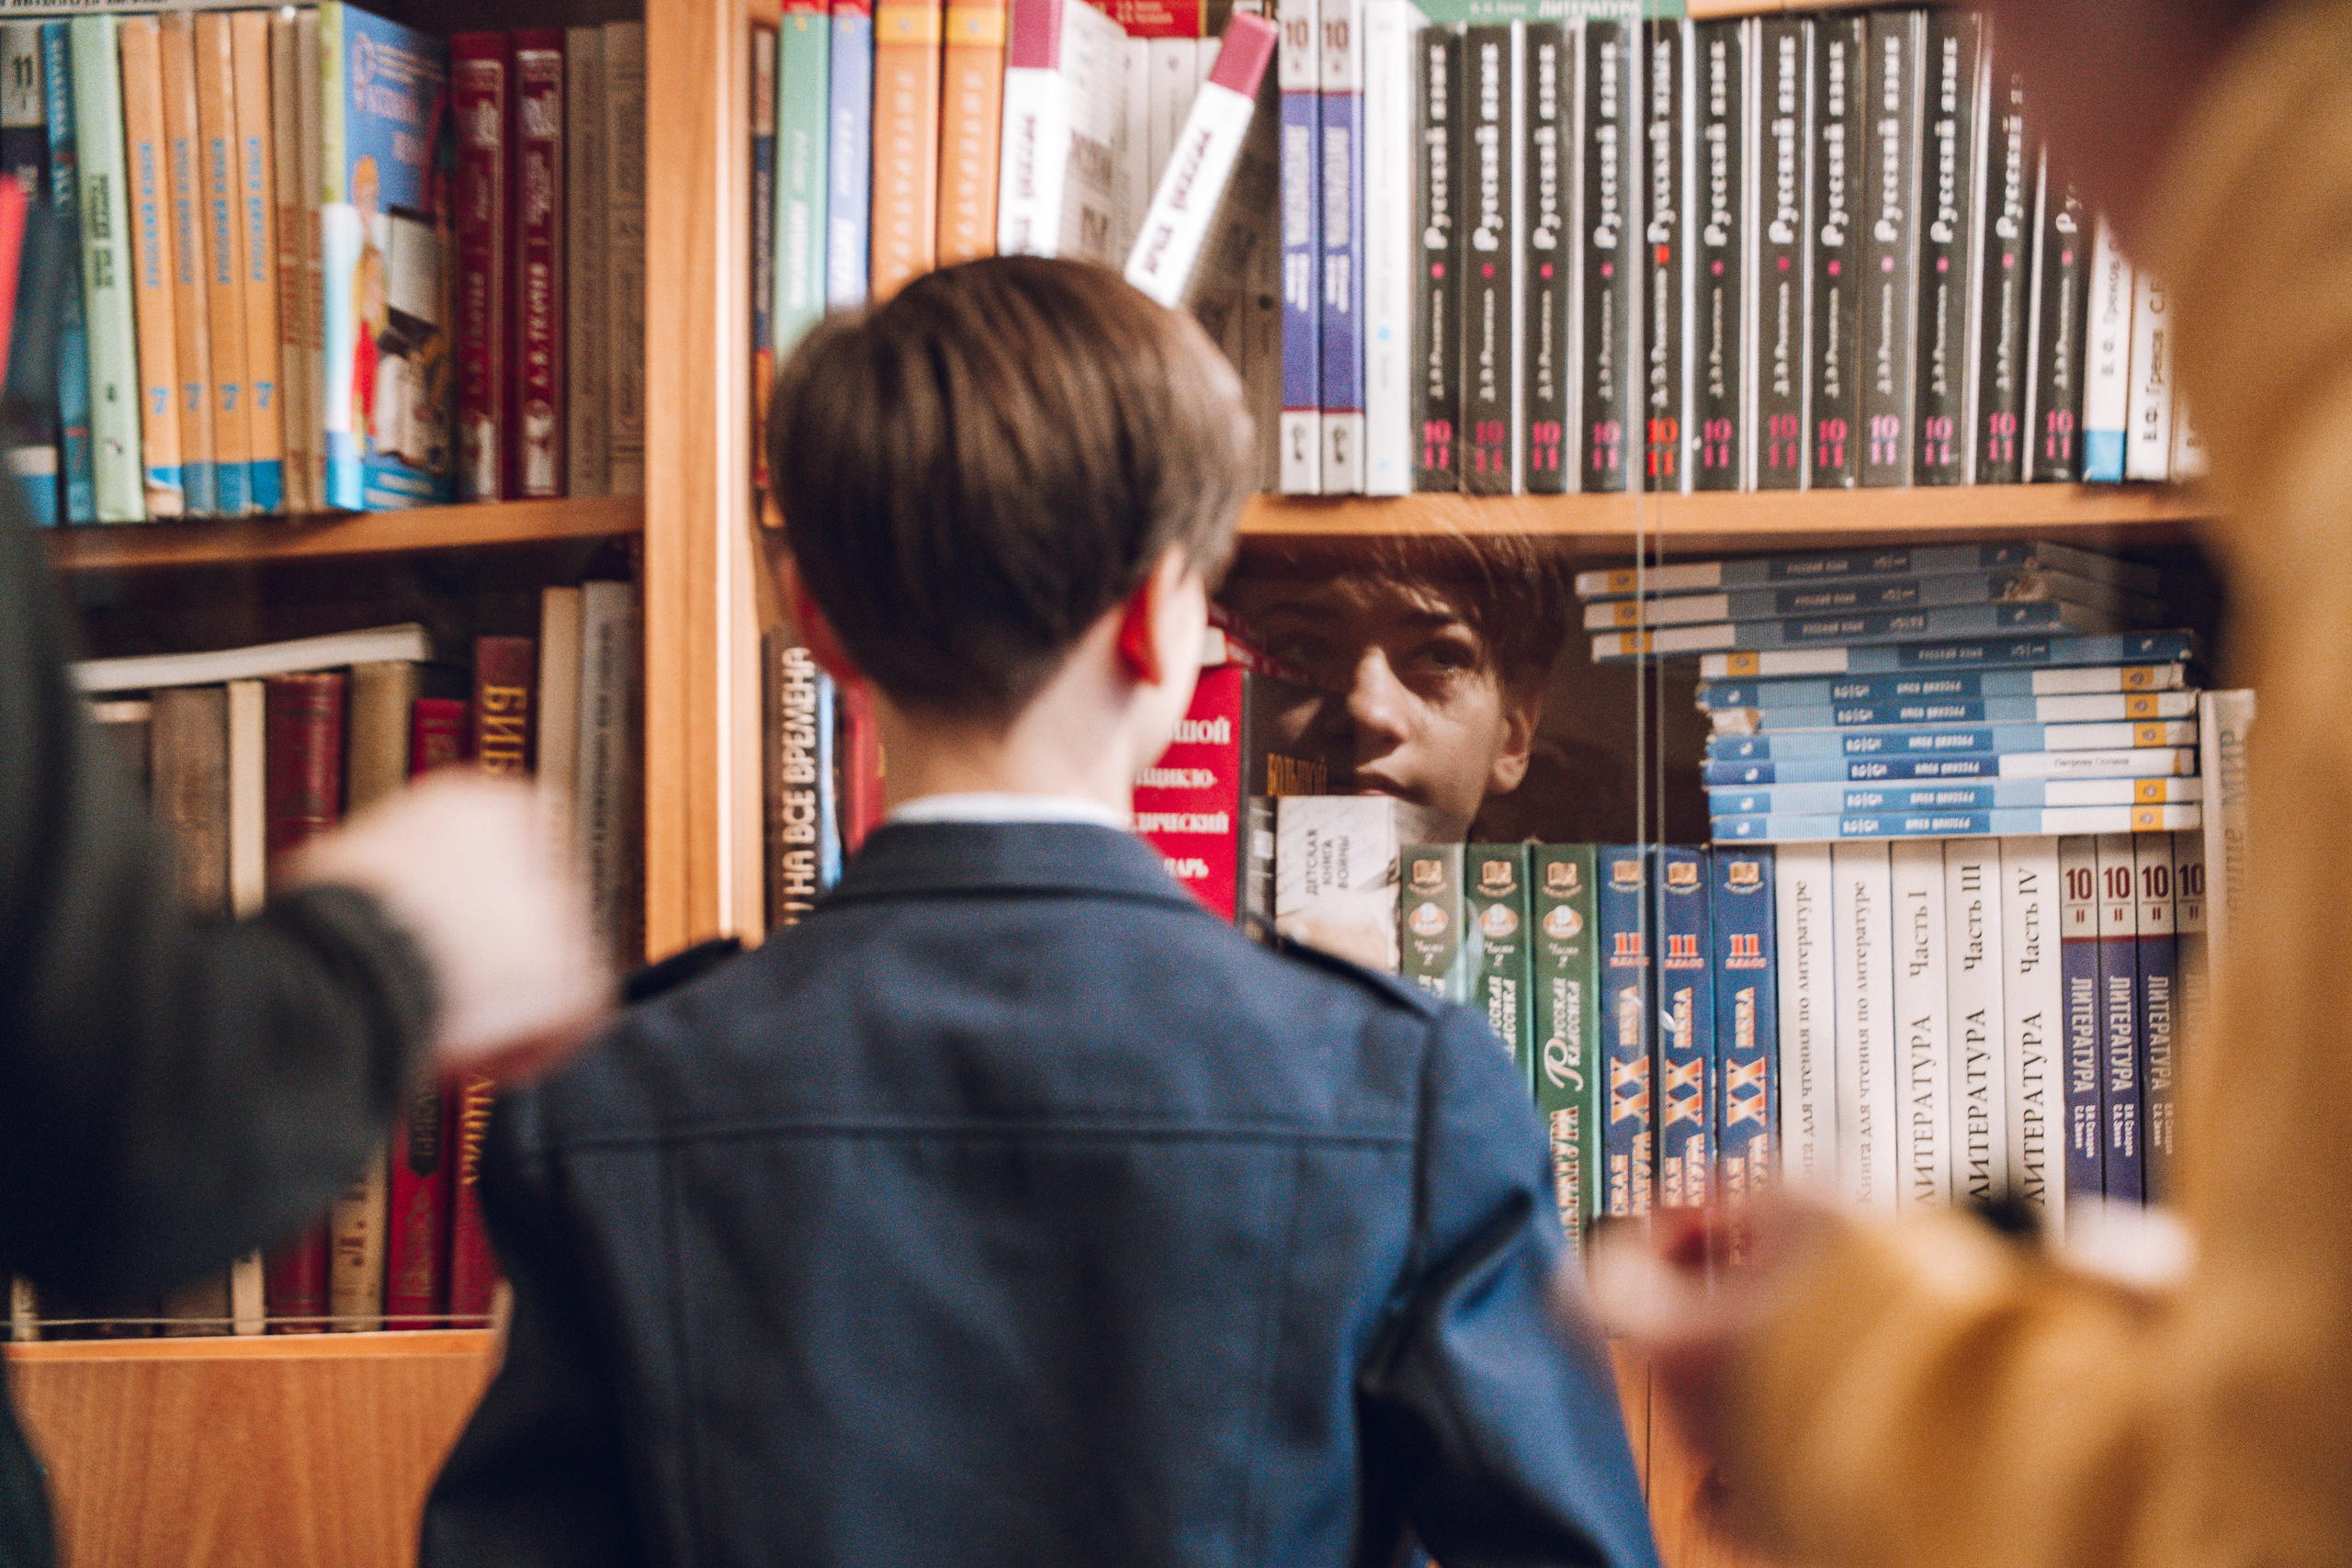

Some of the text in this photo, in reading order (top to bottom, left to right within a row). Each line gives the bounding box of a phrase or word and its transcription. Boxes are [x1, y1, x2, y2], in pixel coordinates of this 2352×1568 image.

[1286, 18, 1308, 49] 10
[1326, 17, 1350, 49] 10
[150, 388, 169, 415] 7
[186, 384, 203, 411] 7
[220, 384, 239, 411] 7
[254, 380, 274, 409] 7
[1424, 421, 1452, 445] 10
[1476, 420, 1504, 446] 10
[1533, 422, 1560, 445] 10
[1593, 422, 1621, 445] 10
[1648, 418, 1678, 445] 10
[1704, 419, 1731, 443] 10
[1770, 413, 1798, 441] 10
[1819, 418, 1848, 443] 10
[1871, 414, 1900, 438] 10
[1926, 417, 1953, 441] 10
[1989, 412, 2017, 436] 10
[2047, 410, 2074, 434] 10
[1424, 446, 1449, 470] 11
[1533, 446, 1558, 470] 11
[1593, 446, 1617, 470] 11
[1704, 444, 1729, 468] 11
[1770, 443, 1796, 468] 11
[1819, 444, 1844, 467] 11
[1871, 440, 1896, 466] 11
[1926, 443, 1950, 466] 11
[1989, 437, 2013, 461] 11
[2047, 435, 2071, 459] 11
[1476, 448, 1503, 474] 11
[1648, 449, 1674, 476] 11
[782, 647, 816, 895] НА ВСЕ ВРЕМЕНА
[1305, 829, 1318, 896] ДЕТСКАЯ
[1322, 840, 1333, 885] КНИГА
[2065, 868, 2093, 901] 10
[2104, 866, 2131, 900] 10
[2142, 865, 2169, 898] 10
[2178, 864, 2205, 898] 10
[1612, 932, 1642, 956] 11
[1668, 933, 1698, 957] 11
[1729, 933, 1760, 957] 11
[1852, 881, 1871, 991] литературе
[1908, 907, 1928, 977] Часть
[1566, 980, 1581, 1066] КЛАССИКА
[1736, 987, 1755, 1048] ВЕКА
[1793, 881, 1815, 1138] для чтения по литературе
[1855, 998, 1870, 1021] по
[1962, 864, 1991, 1202] ЛИТЕРАТУРА Часть III
[2018, 867, 2047, 1204] ЛИТЕРАТУРА Часть IV
[2071, 977, 2095, 1094] ЛИТЕРАТУРА
[2109, 976, 2133, 1092] ЛИТЕРАТУРА
[2148, 975, 2172, 1091] ЛИТЕРАТУРА
[1857, 1028, 1871, 1098] чтения
[1611, 1055, 1650, 1125] XX
[1665, 1056, 1703, 1126] XX
[1726, 1055, 1766, 1127] XX
[1858, 1104, 1872, 1138] для
